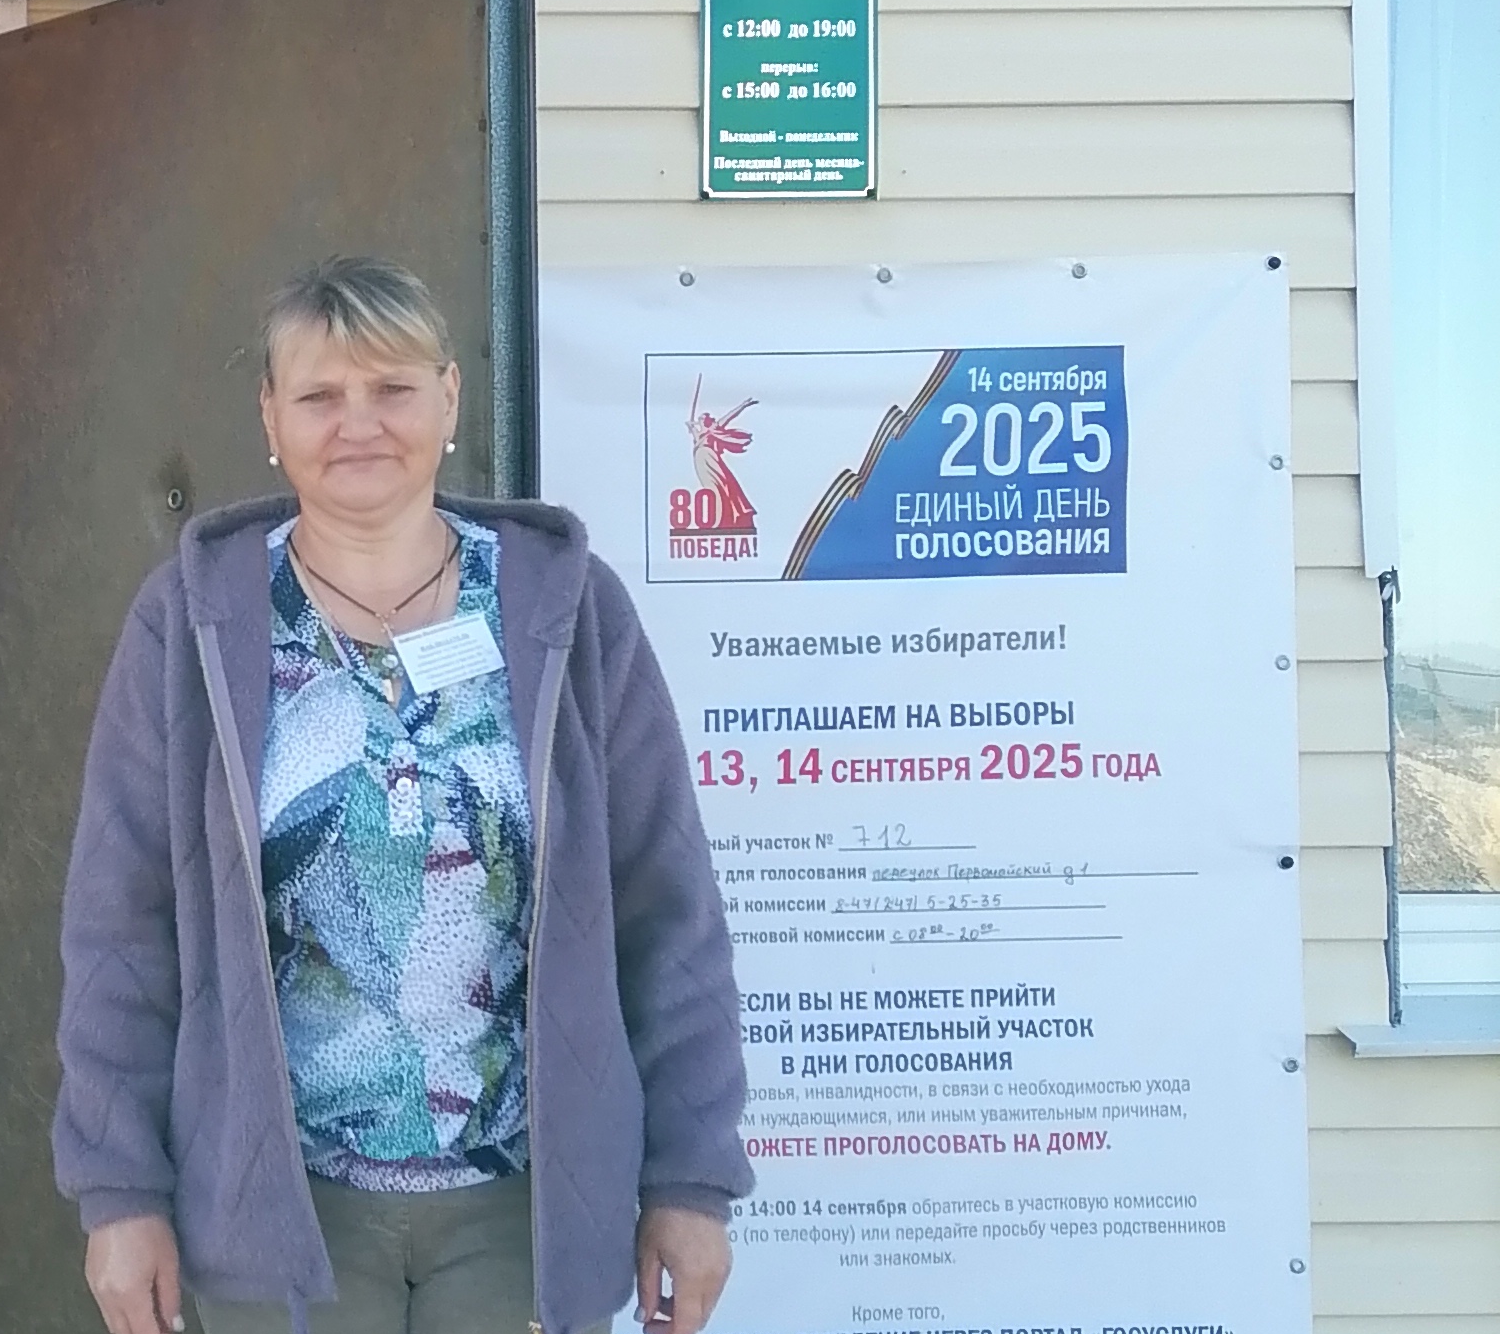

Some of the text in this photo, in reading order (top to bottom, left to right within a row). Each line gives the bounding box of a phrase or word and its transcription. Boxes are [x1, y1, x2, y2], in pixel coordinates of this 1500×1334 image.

[722, 19, 856, 38] с 12:00 до 19:00
[761, 63, 819, 75] перерыв:
[722, 82, 856, 100] с 15:00 до 16:00
[720, 130, 776, 143] Выходной
[786, 131, 859, 143] понедельник
[714, 157, 782, 169] Последний
[784, 158, 813, 169] день
[734, 170, 843, 184] санитарный день
[967, 365, 1107, 396] 14 сентября
[939, 399, 1112, 477] 2025
[669, 488, 721, 529] 80
[894, 484, 1111, 525] ЕДИНЫЙ ДЕНЬ
[669, 536, 759, 561] ПОБЕДА!
[710, 626, 1067, 660] Уважаемые избиратели!
[703, 701, 1075, 734] ПРИГЛАШАЕМ НА ВЫБОРЫ
[696, 743, 1162, 795] 13, 14 СЕНТЯБРЯ 2025 ГОДА
[745, 835, 810, 854] участок
[815, 834, 834, 848] №
[852, 822, 912, 848] 712
[725, 868, 755, 884] для
[760, 867, 867, 882] голосования
[744, 898, 826, 912] комиссии
[926, 893, 1002, 911] 5-25-35
[804, 928, 885, 942] комиссии
[798, 991, 834, 1012] ВЫ
[839, 990, 868, 1011] НЕ
[874, 987, 963, 1010] МОЖЕТЕ
[969, 980, 1056, 1008] ПРИЙТИ
[800, 1014, 992, 1044] ИЗБИРАТЕЛЬНЫЙ
[997, 1018, 1094, 1040] УЧАСТОК
[781, 1048, 1014, 1077] В ДНИ ГОЛОСОВАНИЯ
[805, 1085, 923, 1102] инвалидности,
[928, 1085, 937, 1097] в
[942, 1083, 988, 1097] связи
[994, 1083, 1003, 1095] с
[1009, 1079, 1141, 1097] необходимостью
[1146, 1079, 1190, 1095] ухода
[761, 1109, 892, 1129] нуждающимися,
[898, 1110, 925, 1123] или
[931, 1108, 976, 1122] иным
[981, 1105, 1097, 1125] уважительным
[1102, 1104, 1187, 1121] причинам,
[742, 1131, 1112, 1158] ОЖЕТЕ ПРОГОЛОСОВАТЬ НА ДОМУ.
[750, 1200, 796, 1216] 14:00
[803, 1200, 822, 1216] 14
[828, 1199, 906, 1218] сентября
[912, 1197, 1000, 1215] обратитесь
[1005, 1199, 1014, 1211] в
[1018, 1195, 1108, 1215] участковую
[1114, 1194, 1197, 1209] комиссию
[743, 1226, 769, 1245] (по
[774, 1224, 856, 1244] телефону)
[861, 1228, 890, 1241] или
[896, 1224, 978, 1243] передайте
[983, 1220, 1045, 1240] просьбу
[1050, 1221, 1097, 1238] через
[1103, 1219, 1226, 1237] родственников
[839, 1251, 956, 1267] или знакомых.
[852, 1304, 946, 1326] Кроме того,
